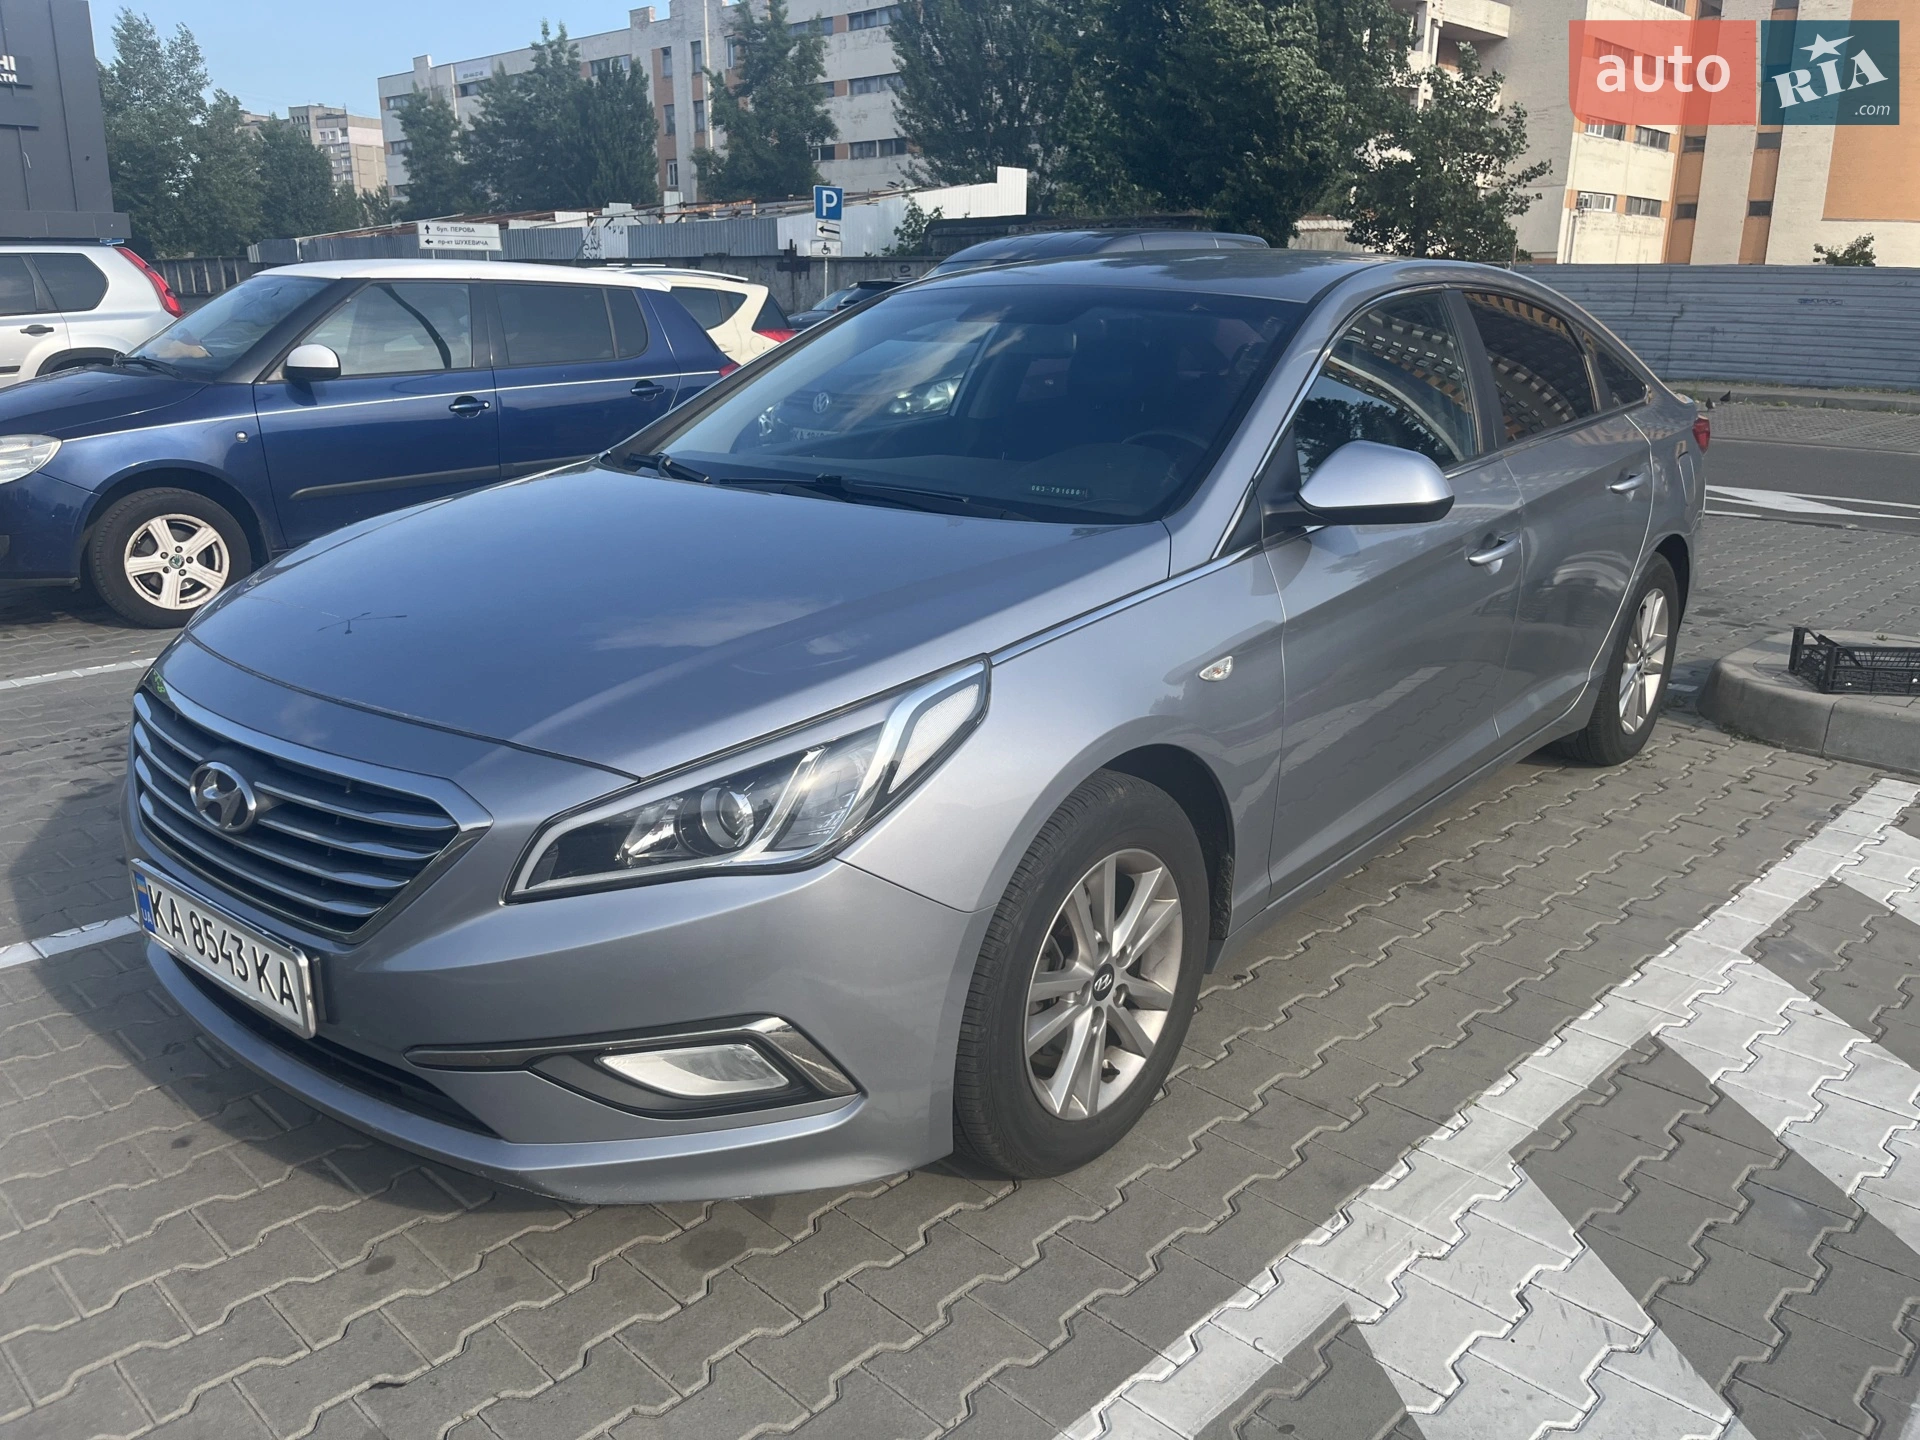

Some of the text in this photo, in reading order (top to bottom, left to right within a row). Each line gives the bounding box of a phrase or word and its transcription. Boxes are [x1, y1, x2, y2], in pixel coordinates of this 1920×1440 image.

[822, 190, 838, 216] P
[141, 907, 154, 925] UA
[148, 884, 299, 1015] KA 8543 KA
